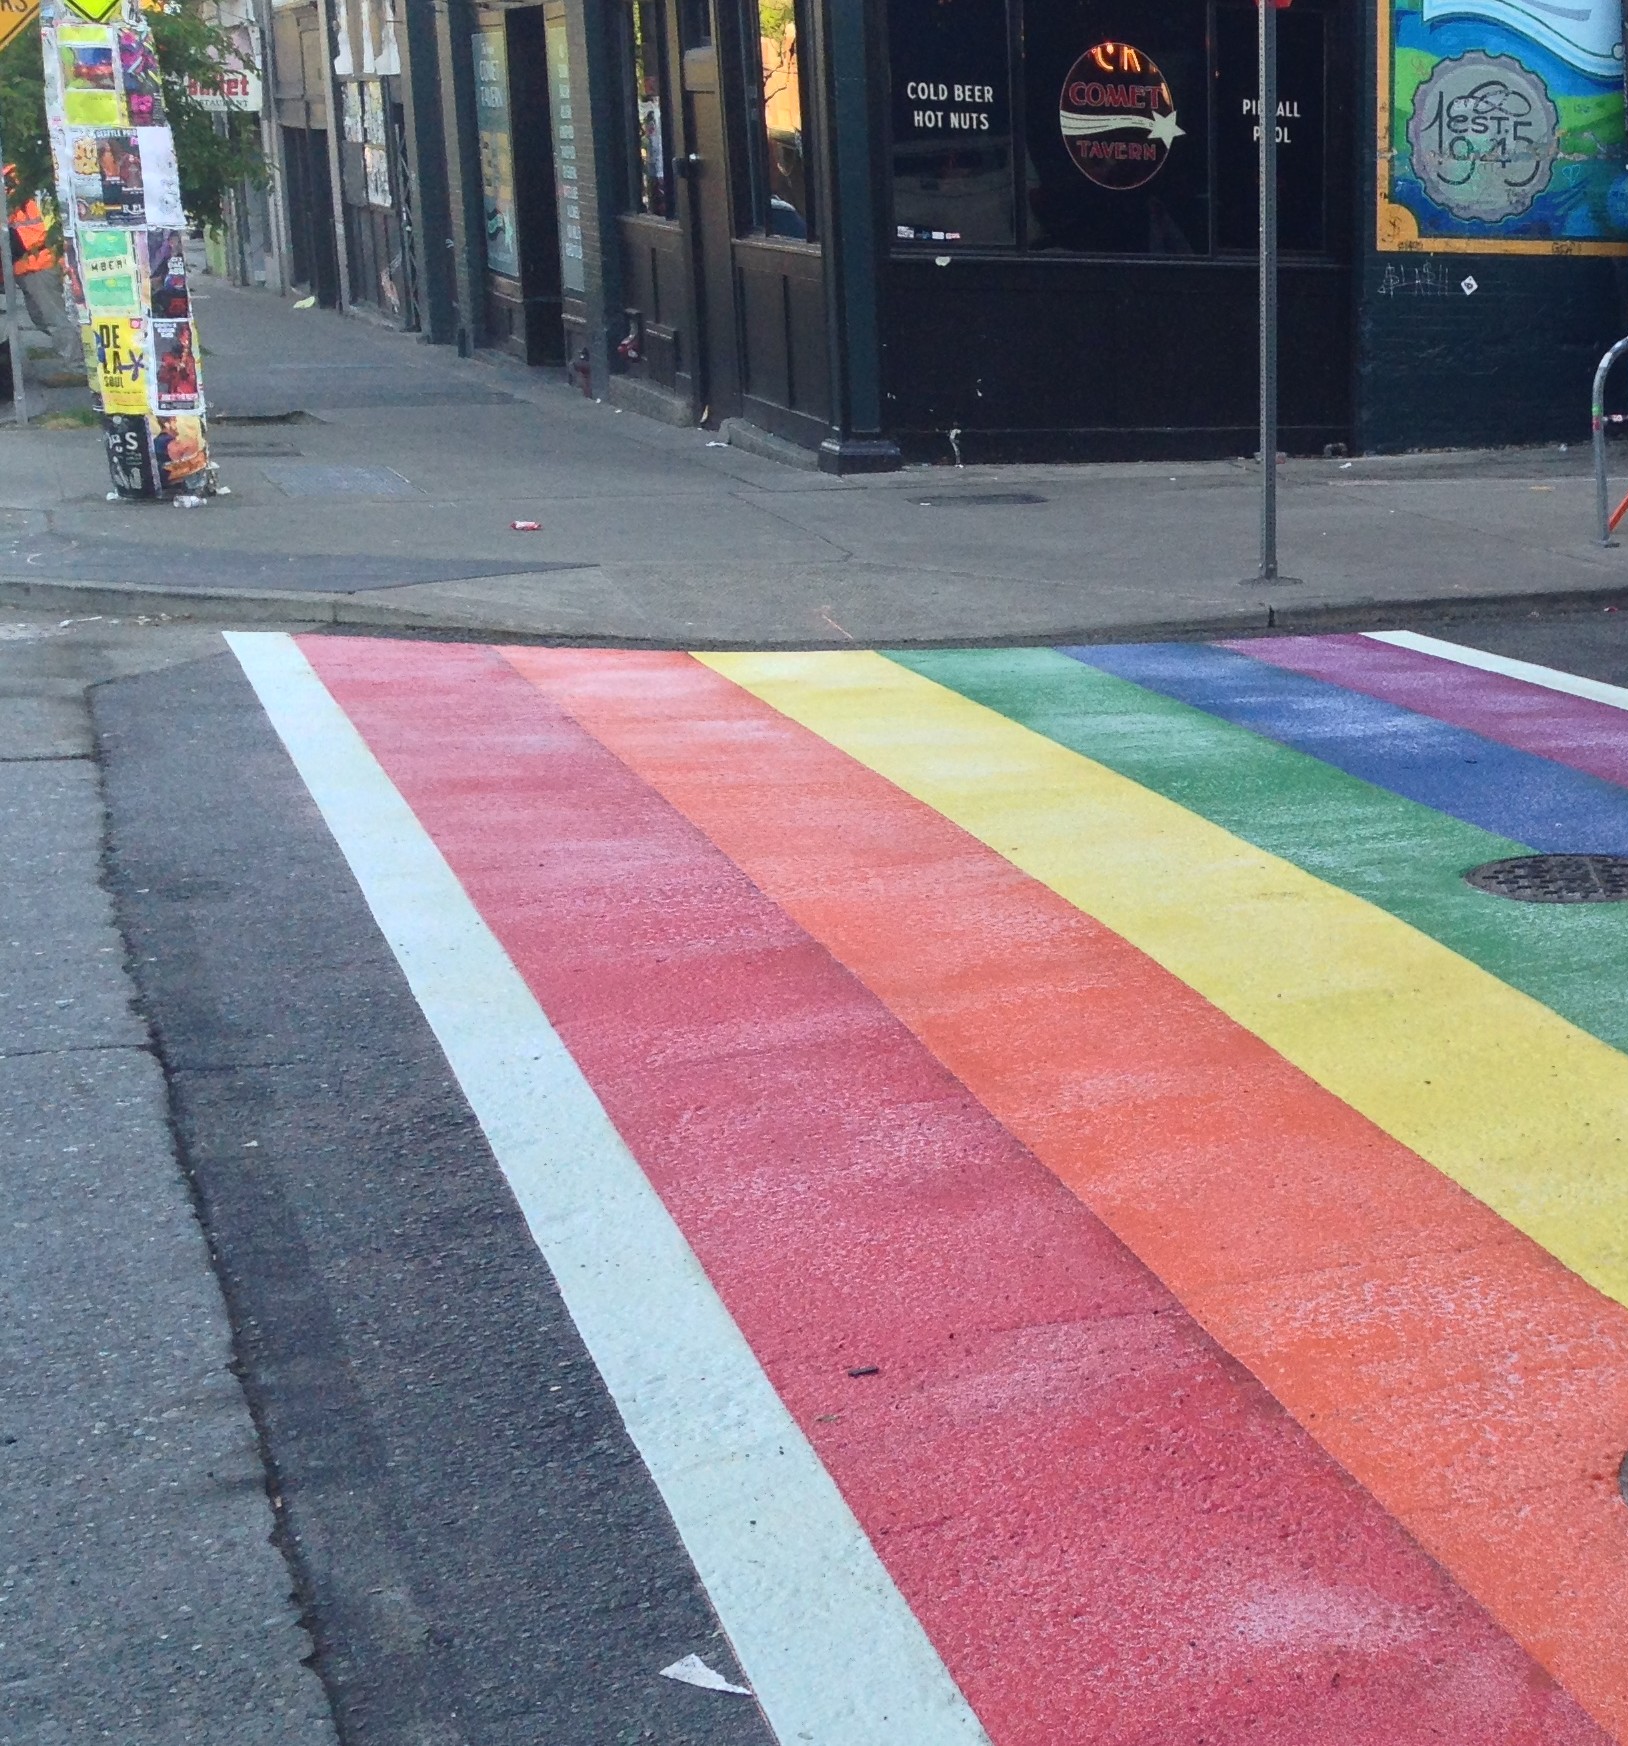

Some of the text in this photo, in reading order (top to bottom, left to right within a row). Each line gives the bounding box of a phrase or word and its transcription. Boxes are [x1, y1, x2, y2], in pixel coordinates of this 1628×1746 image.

[907, 82, 993, 103] COLD BEER
[1068, 81, 1163, 109] COMET
[1242, 98, 1301, 118] PIALL
[914, 110, 990, 130] HOT NUTS
[1253, 126, 1292, 143] POL
[1420, 91, 1541, 187] 1945
[1076, 140, 1158, 160] TAVERN
[99, 324, 121, 349] DE
[103, 375, 123, 388] SOUL
